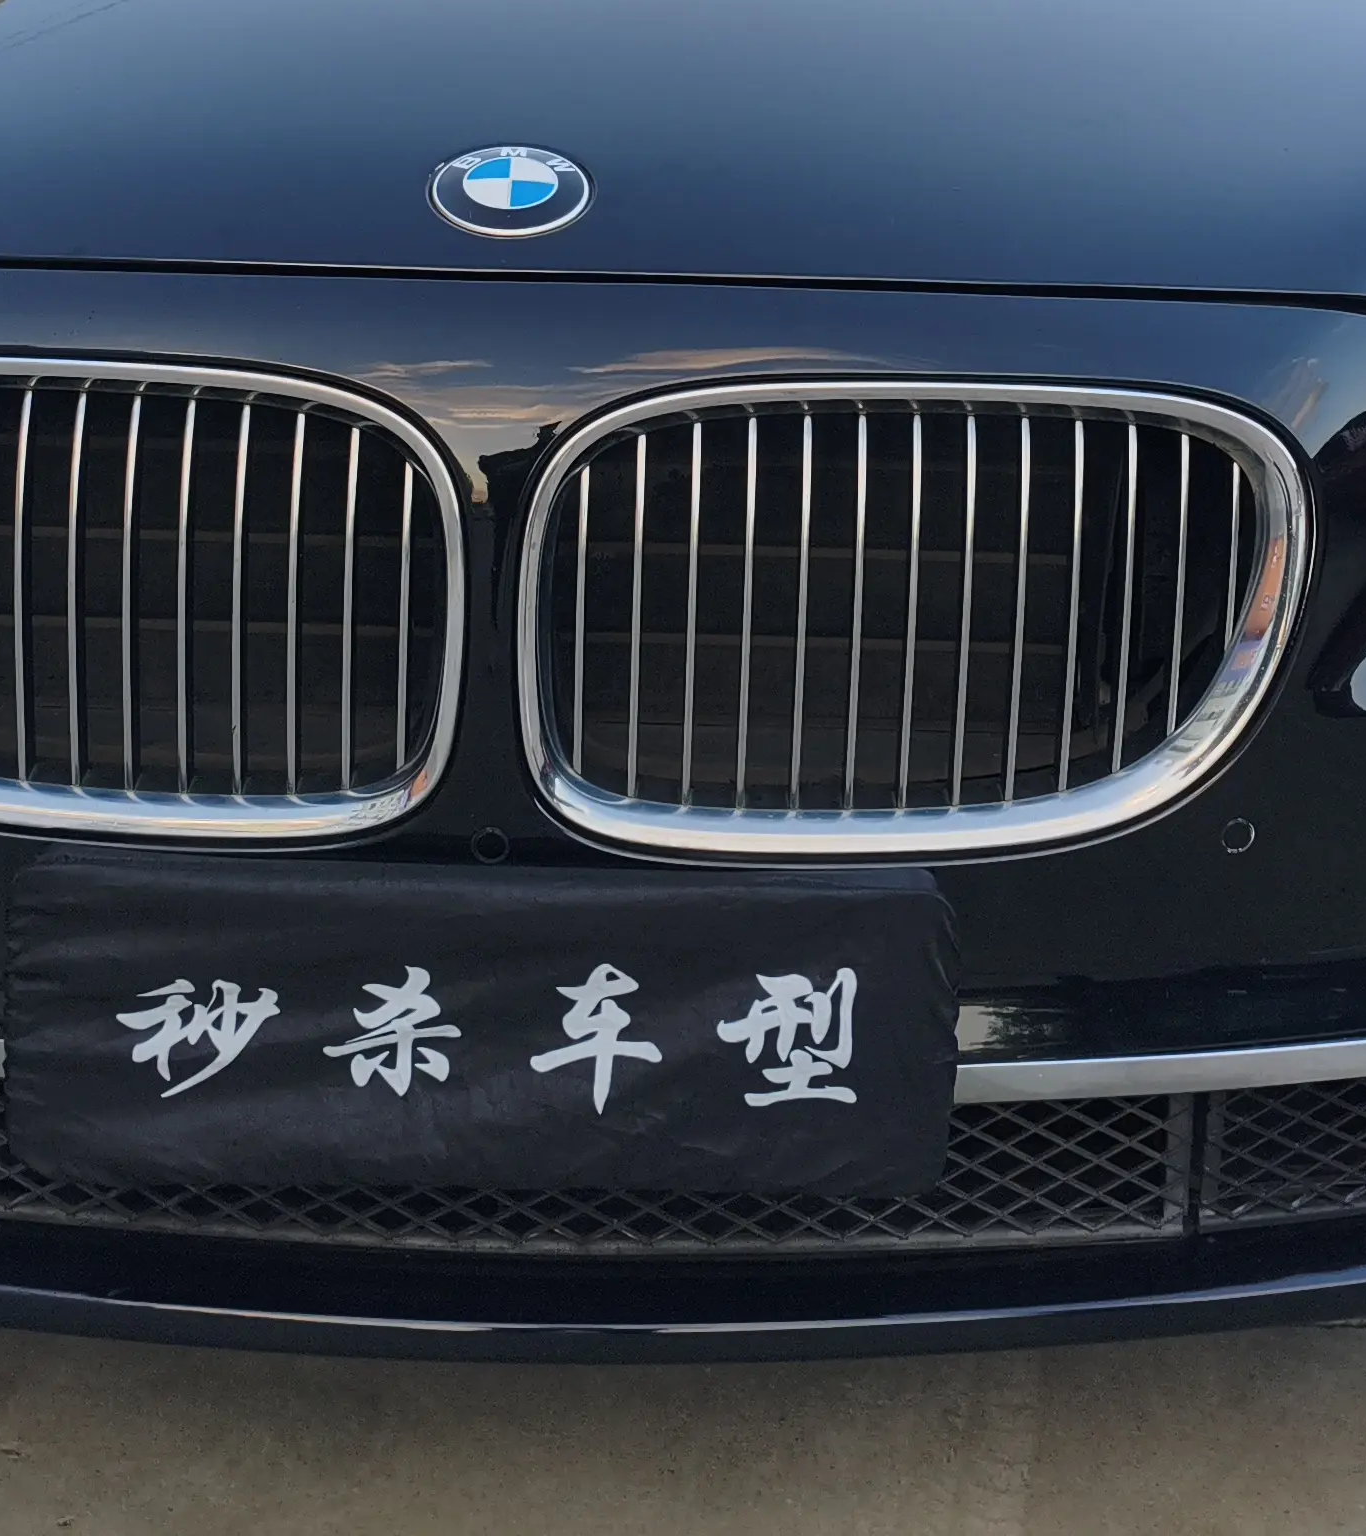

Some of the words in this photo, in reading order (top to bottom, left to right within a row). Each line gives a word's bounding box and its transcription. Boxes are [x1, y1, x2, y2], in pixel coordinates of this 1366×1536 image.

[451, 146, 576, 173] BMW
[115, 962, 858, 1116] 秒杀车型
